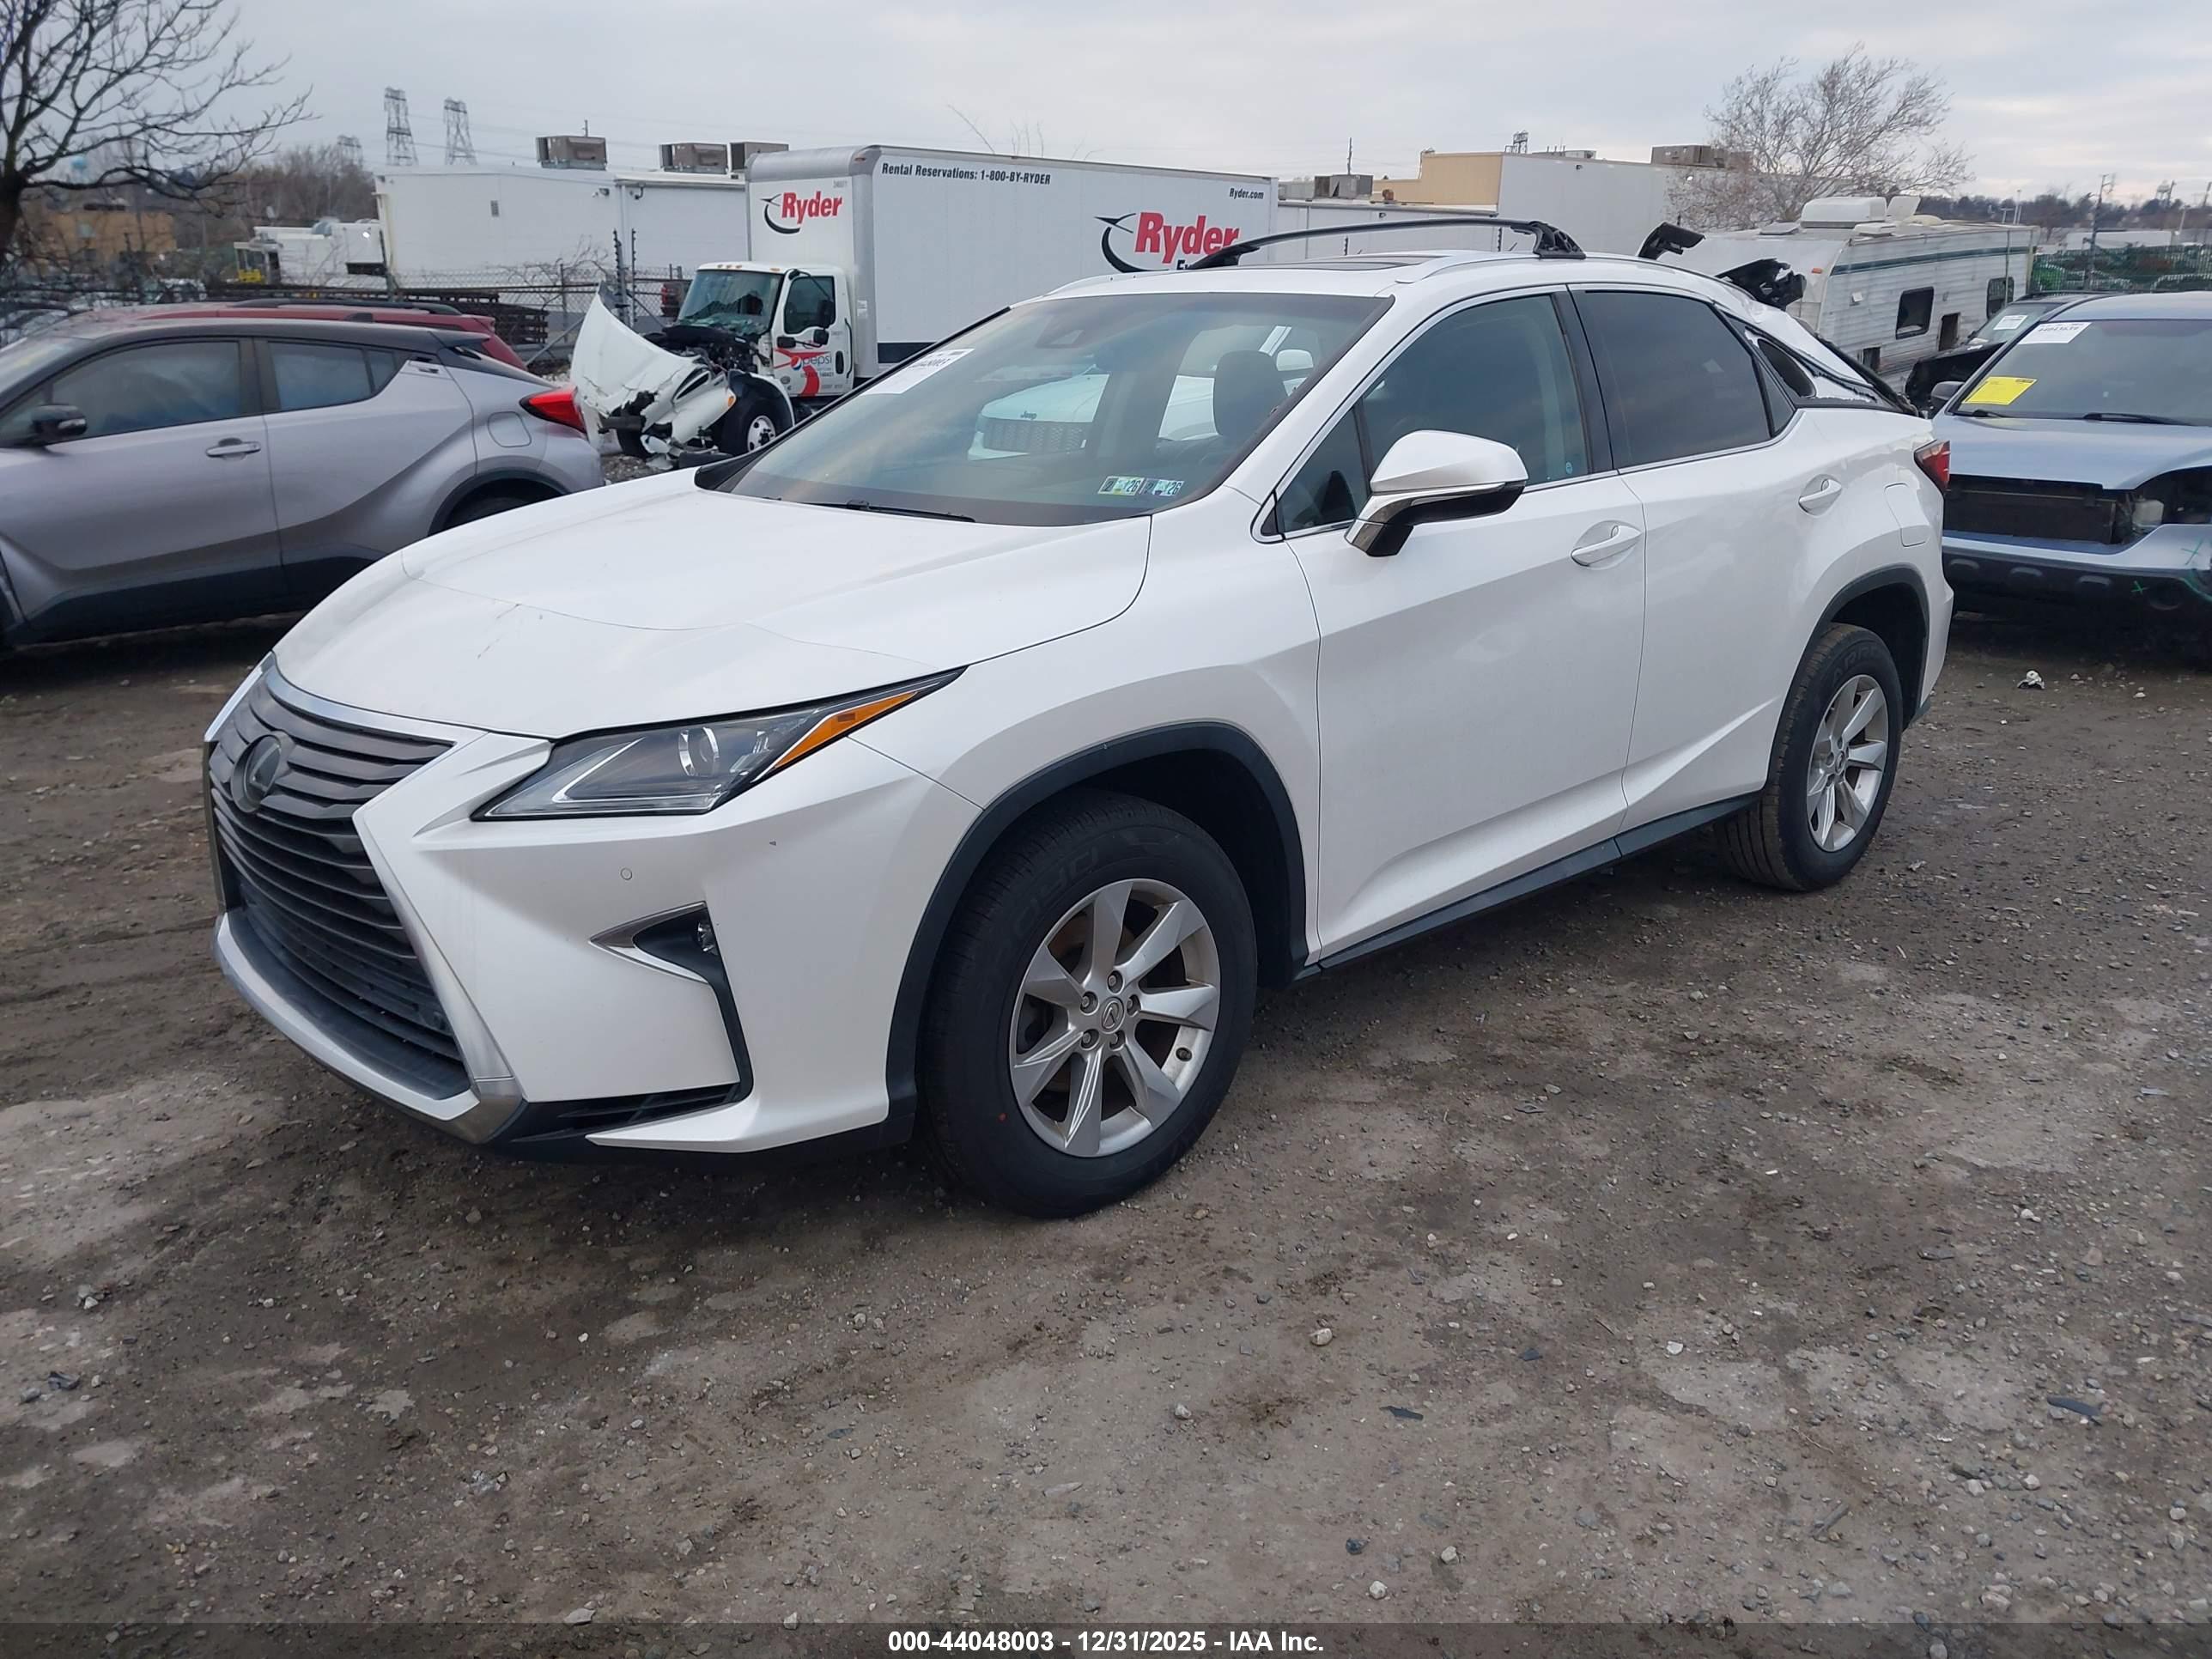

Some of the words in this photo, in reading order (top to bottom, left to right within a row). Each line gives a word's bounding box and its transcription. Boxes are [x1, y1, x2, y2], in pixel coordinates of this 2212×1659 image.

[882, 162, 913, 175] Rental
[915, 164, 977, 179] Reservations:
[981, 169, 1051, 185] 1-800-BY-RYDER
[1229, 187, 1264, 199] Ryder.com
[781, 191, 842, 224] Ryder
[1134, 211, 1240, 264] Ryder
[802, 354, 832, 367] pepsi
